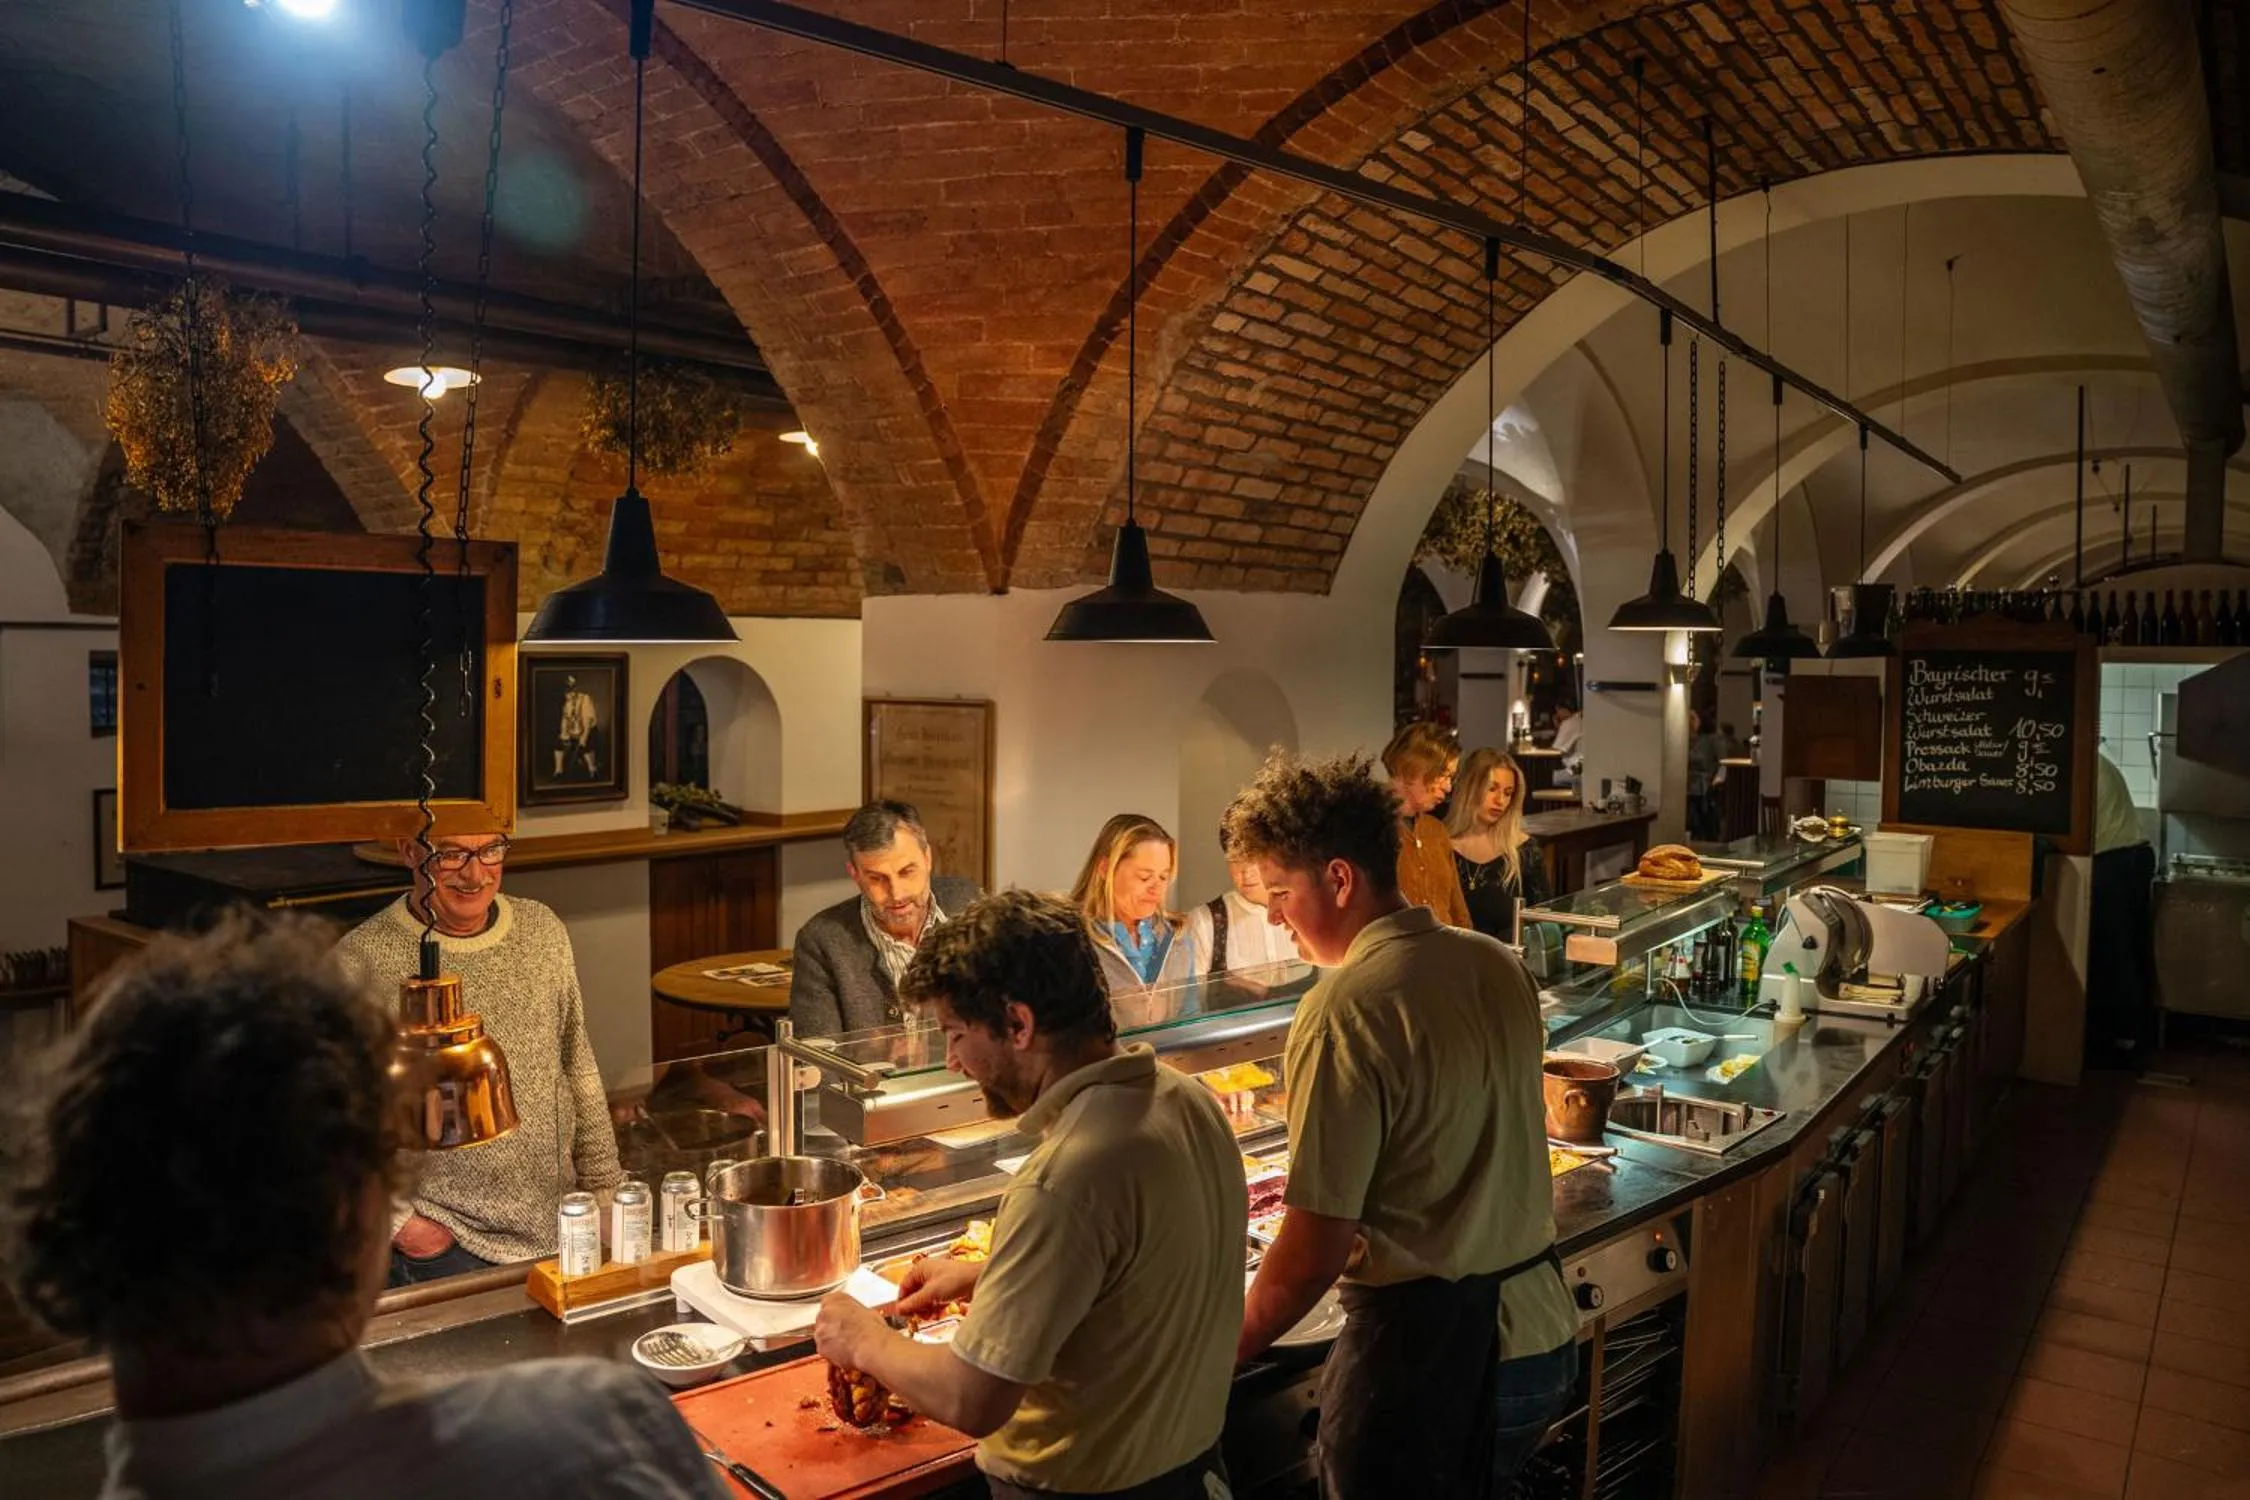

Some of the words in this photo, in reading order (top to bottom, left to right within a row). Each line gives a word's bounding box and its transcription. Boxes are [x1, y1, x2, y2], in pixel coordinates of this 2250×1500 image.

[1909, 659, 2014, 690] Bayrischer
[1907, 686, 1994, 707] Wurstsalat
[1907, 720, 1993, 740] Wurstsalat
[2008, 717, 2065, 741] 10,50
[1904, 740, 1971, 758] Pressack
[1905, 757, 1971, 774] Obazda
[1904, 775, 1977, 796] Limburger
